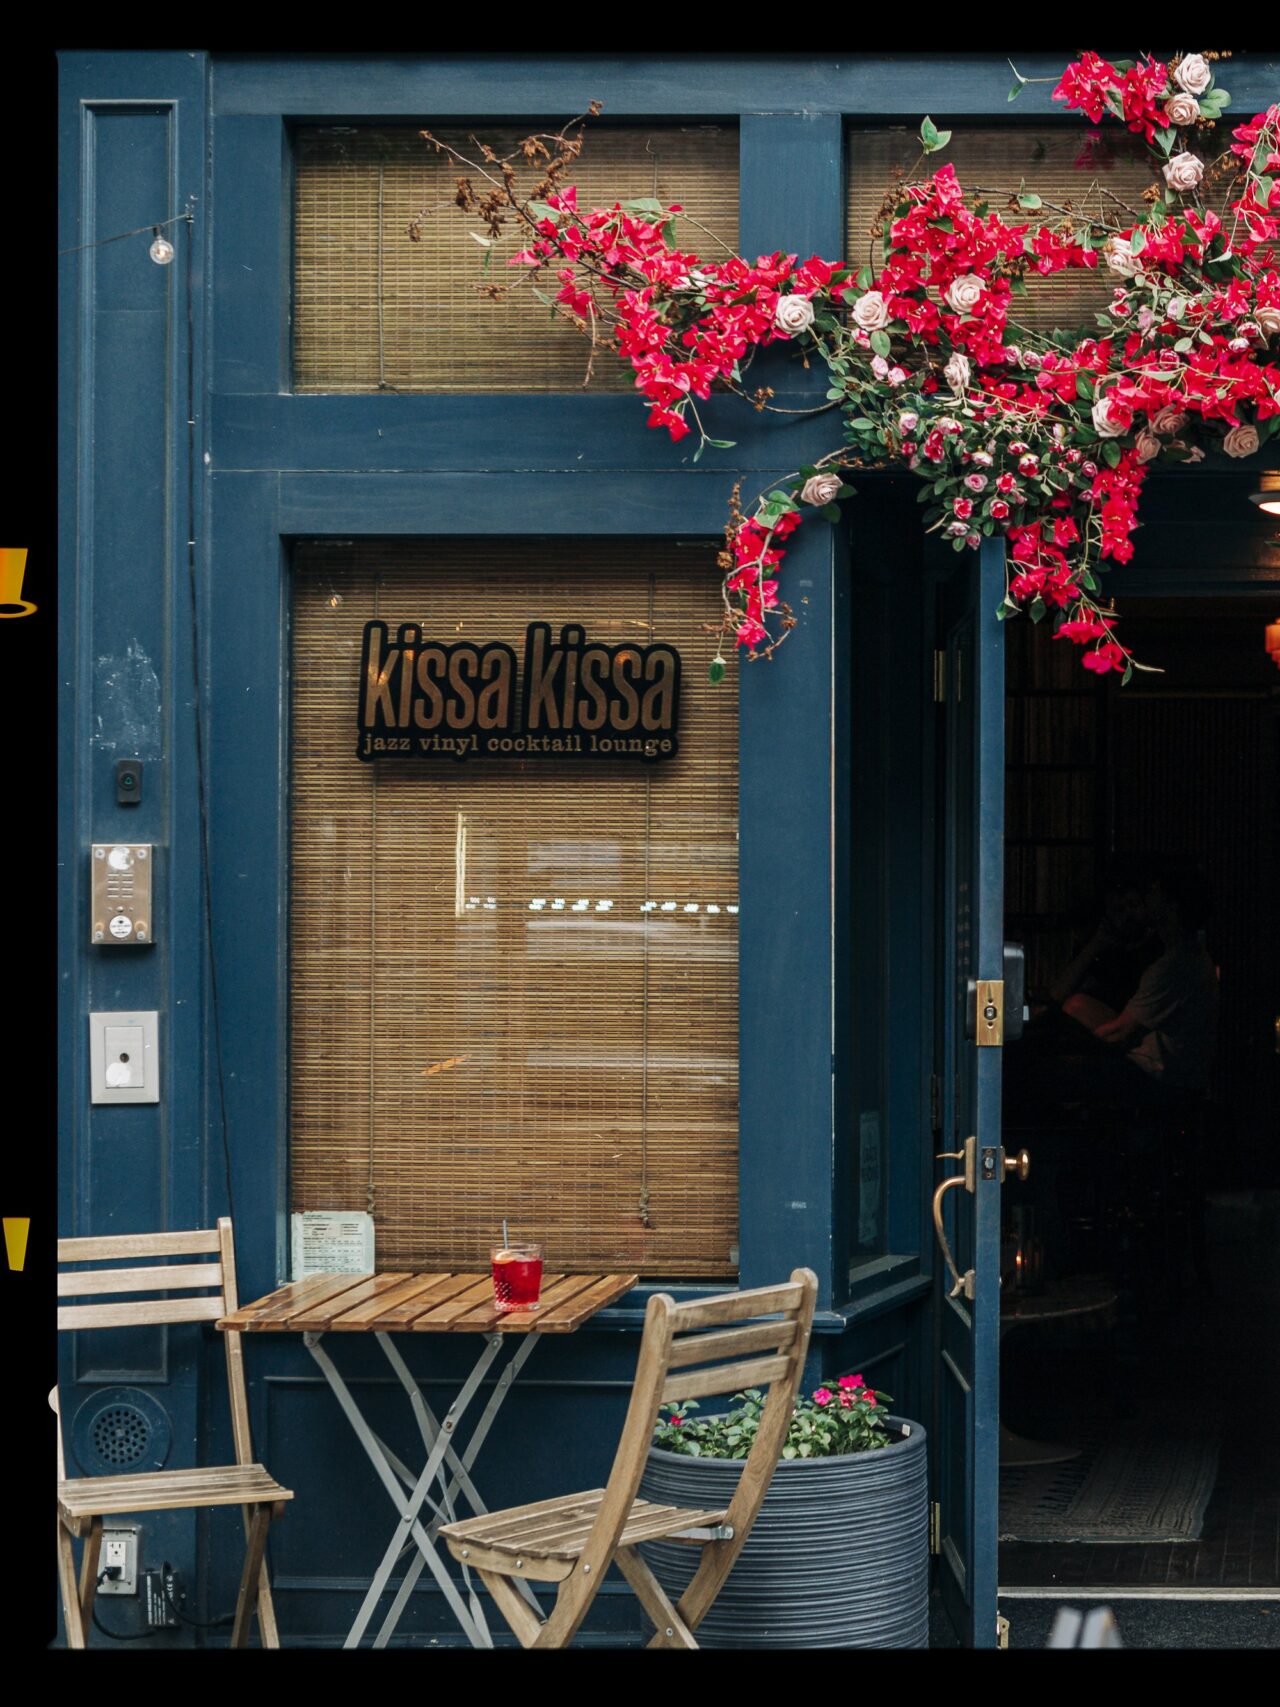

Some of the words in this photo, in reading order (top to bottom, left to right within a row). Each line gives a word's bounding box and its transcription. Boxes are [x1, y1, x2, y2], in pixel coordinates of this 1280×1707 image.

[364, 627, 511, 729] kissa
[527, 628, 675, 731] kissa
[363, 733, 411, 754] jazz
[419, 734, 478, 756] vinyl
[487, 734, 582, 752] cocktail
[590, 734, 672, 755] lounge
